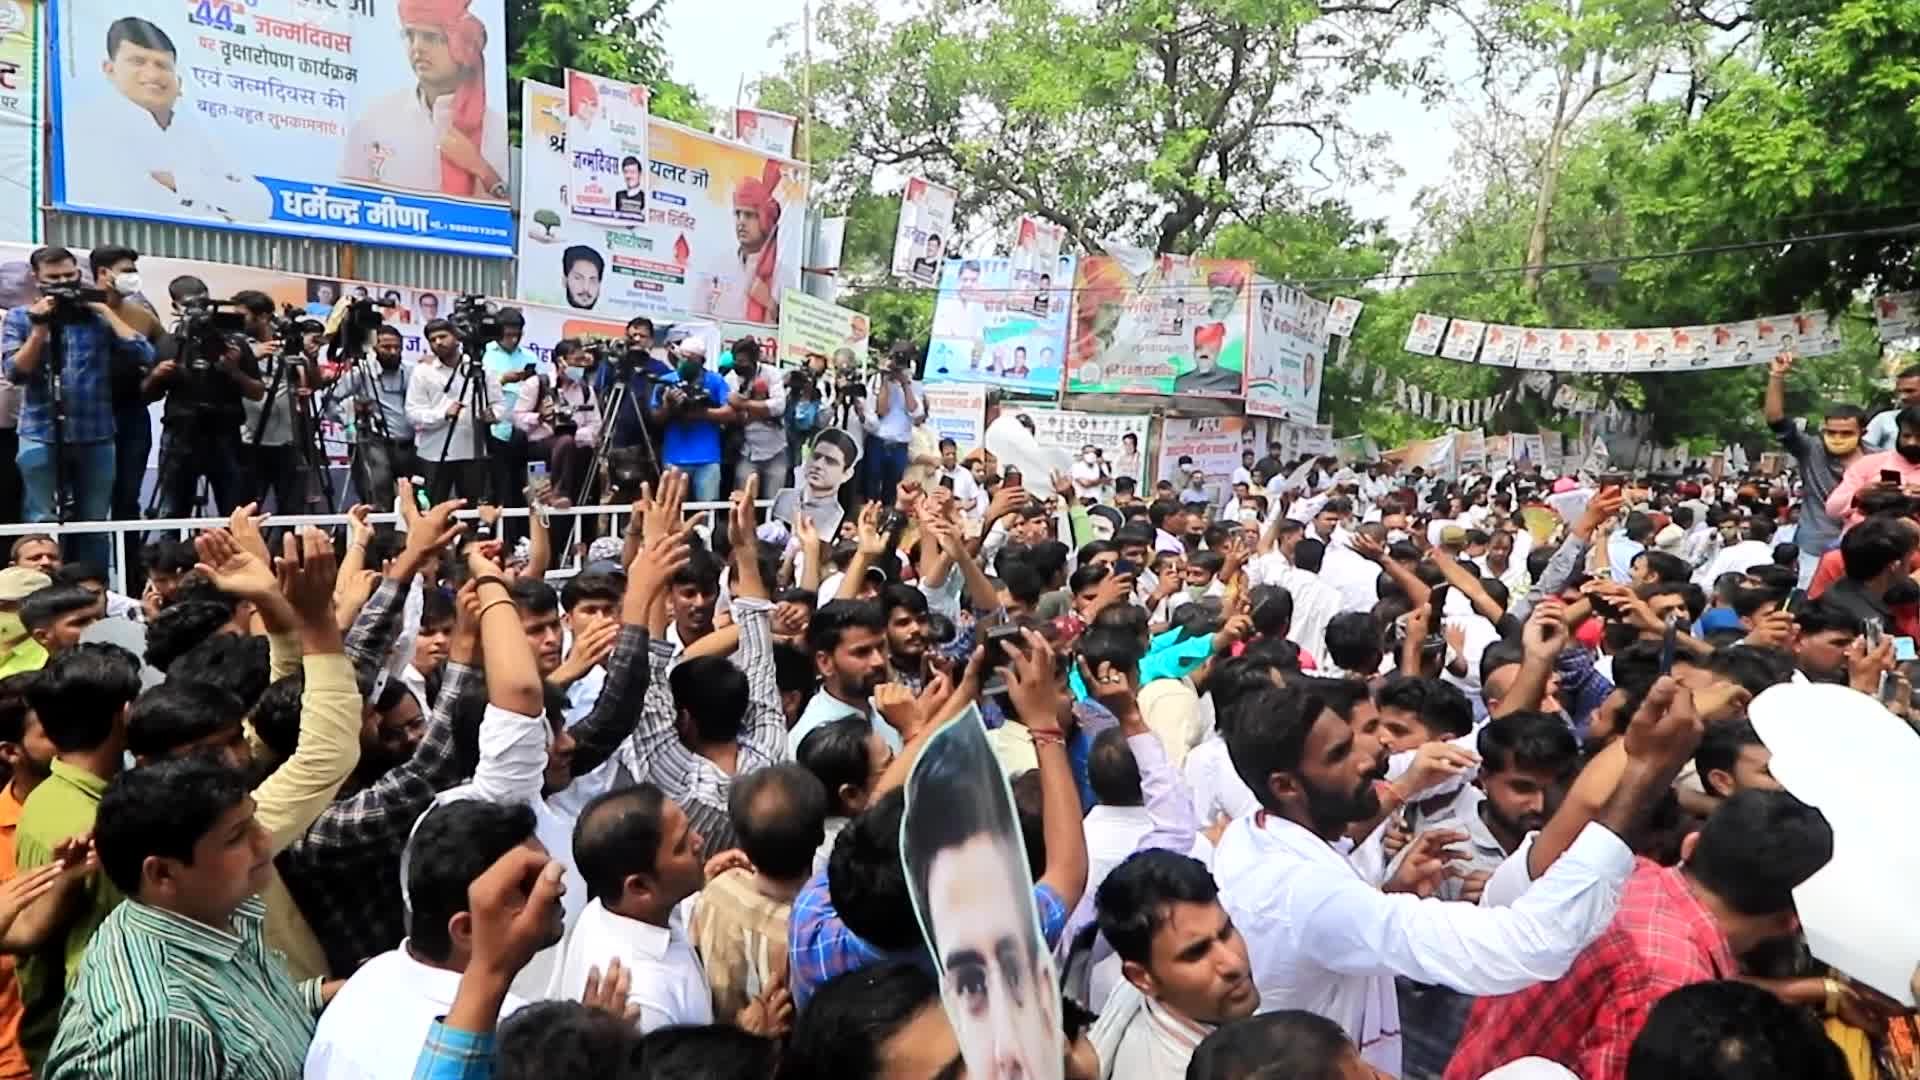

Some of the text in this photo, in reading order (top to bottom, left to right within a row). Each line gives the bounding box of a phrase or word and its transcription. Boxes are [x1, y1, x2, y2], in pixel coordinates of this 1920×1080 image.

[254, 15, 352, 54] जन्मदिवस
[220, 40, 295, 71] वृक्षारोपण
[299, 57, 358, 83] कार्यक्रम
[192, 66, 347, 111] एवं जन्मदिवस की
[363, 197, 429, 232] मीणा
